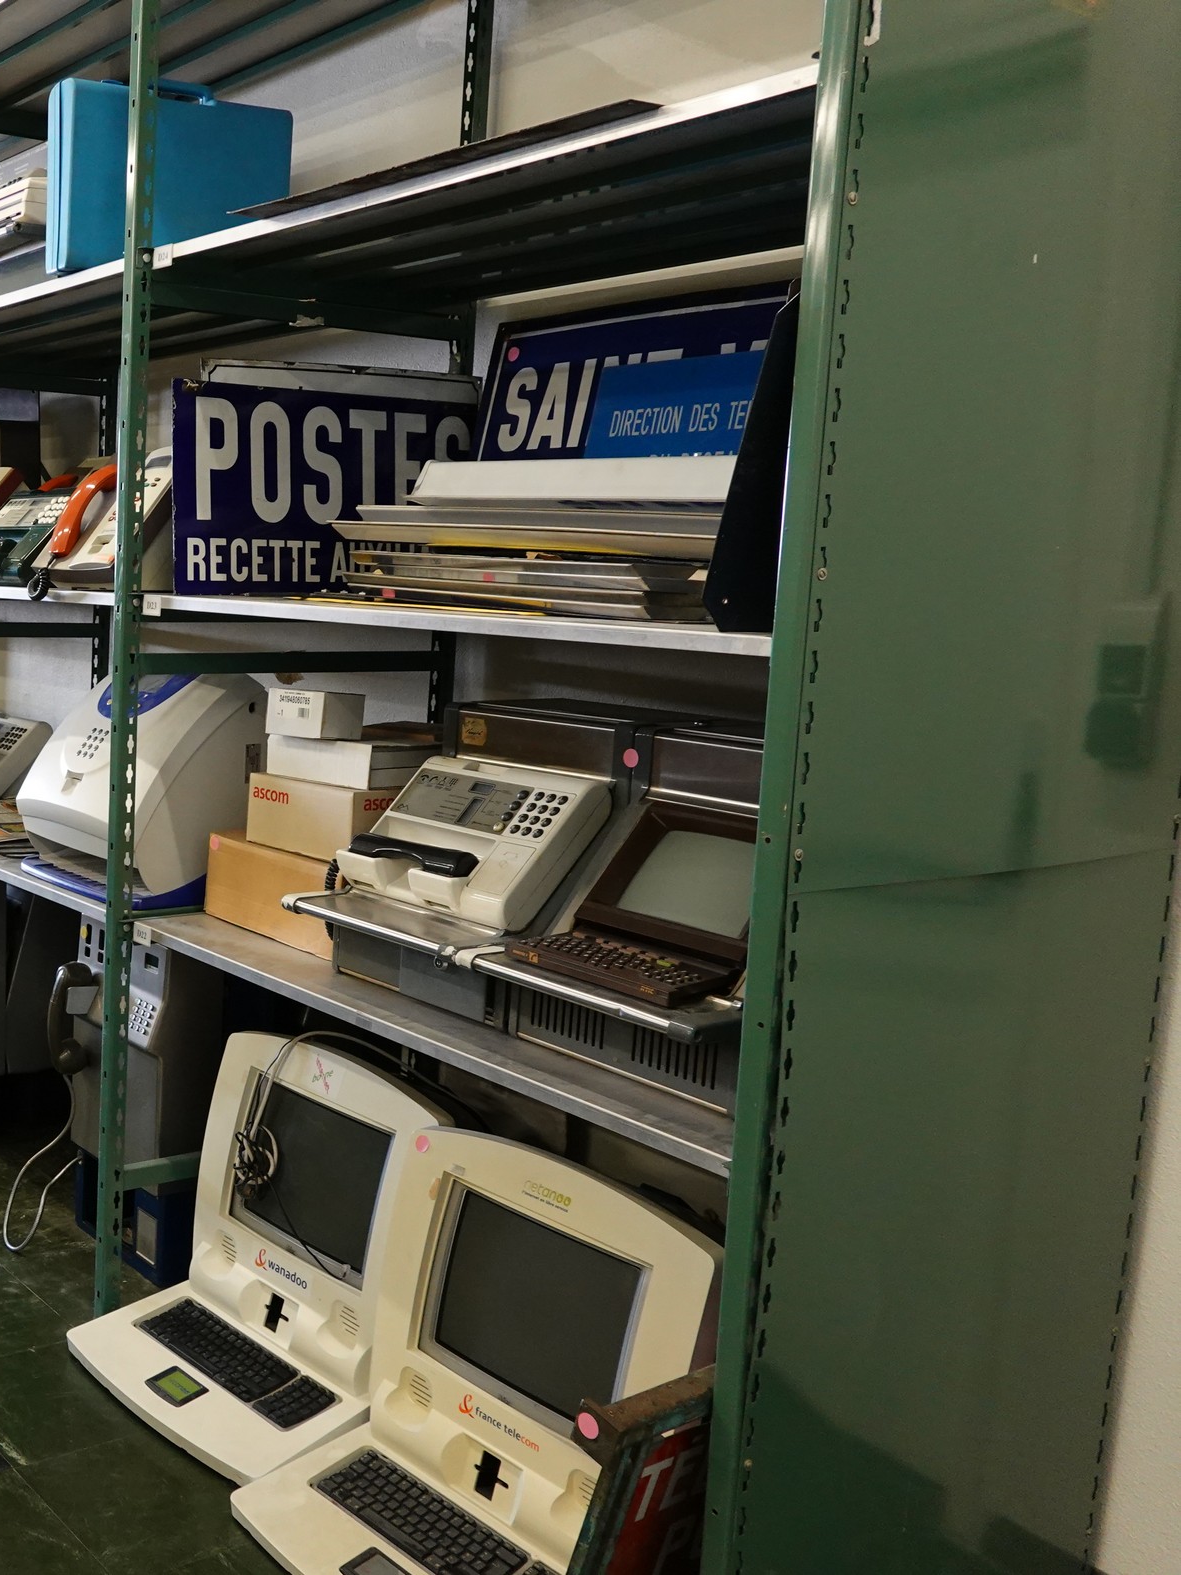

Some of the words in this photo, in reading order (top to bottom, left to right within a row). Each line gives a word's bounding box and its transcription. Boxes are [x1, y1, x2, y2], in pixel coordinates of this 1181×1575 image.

[609, 405, 684, 438] DIRECTION
[688, 403, 720, 433] DES
[187, 537, 321, 583] RECETTE
[253, 786, 289, 805] ascom
[267, 1260, 308, 1290] wanadoo
[475, 1406, 502, 1430] france
[503, 1424, 540, 1452] telecom
